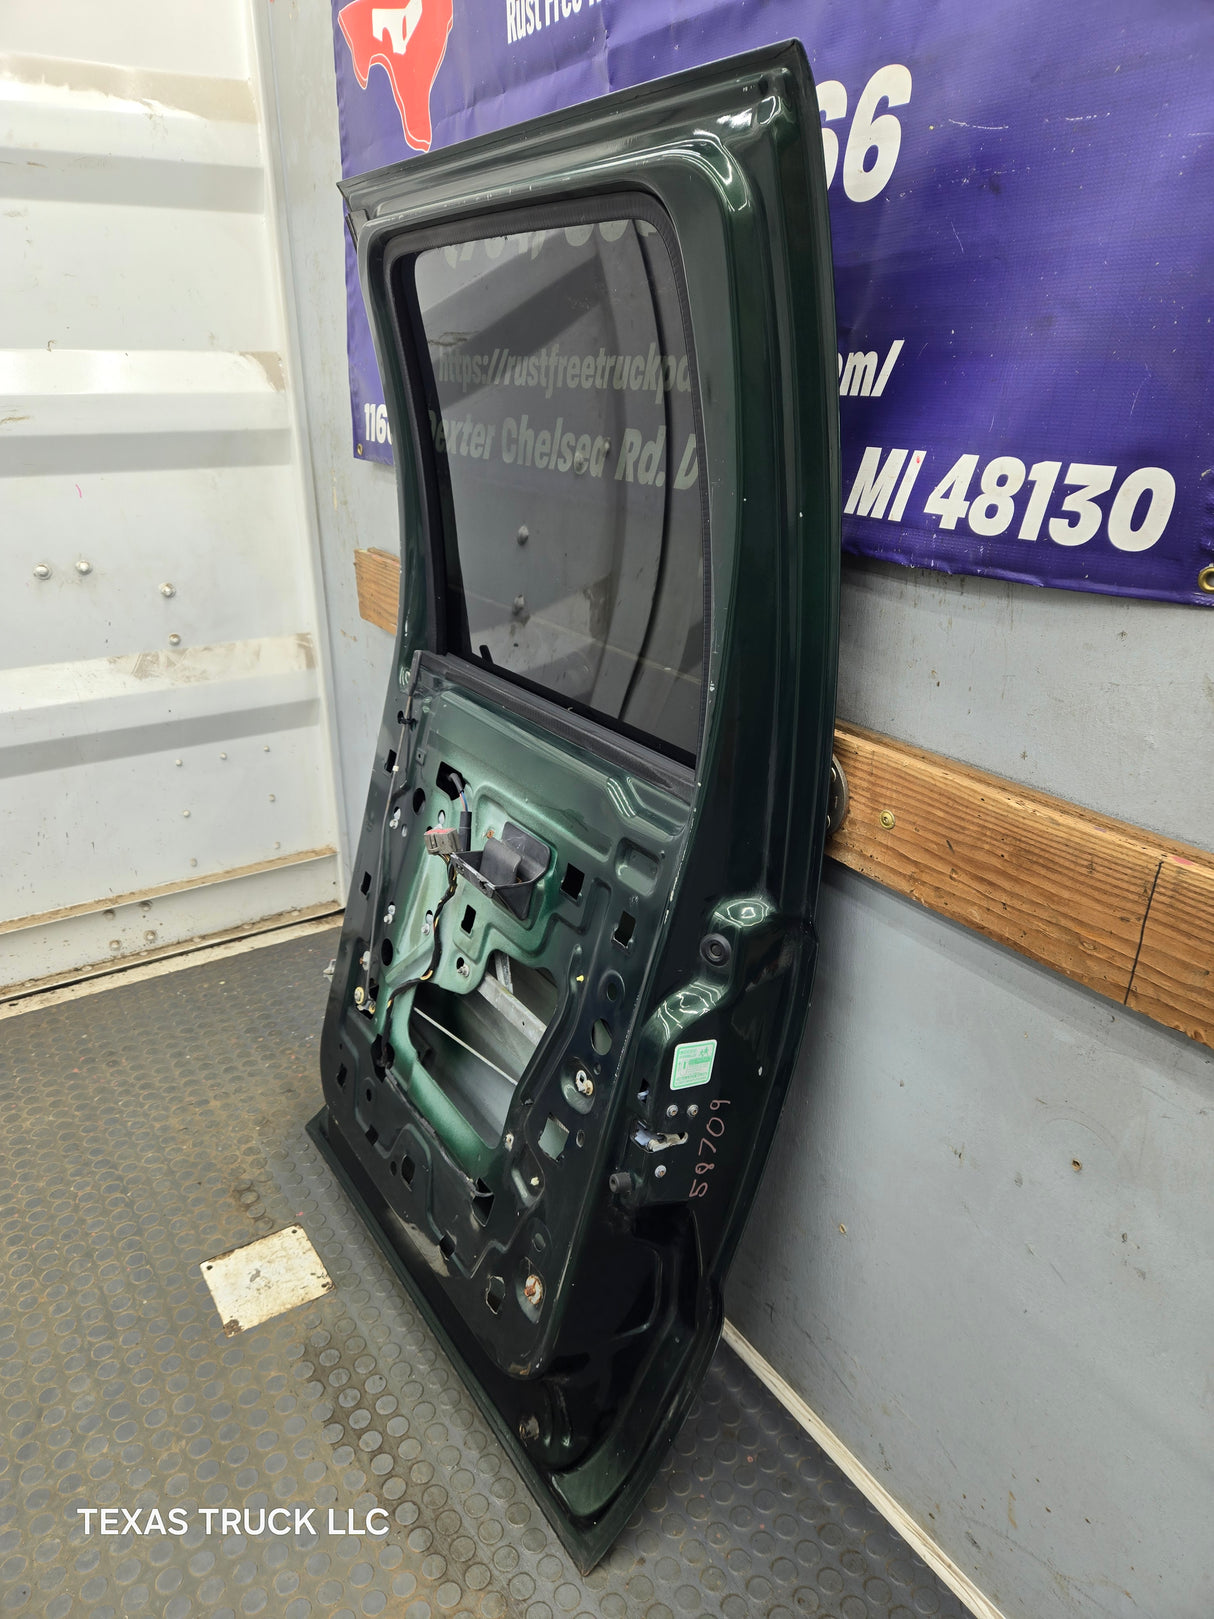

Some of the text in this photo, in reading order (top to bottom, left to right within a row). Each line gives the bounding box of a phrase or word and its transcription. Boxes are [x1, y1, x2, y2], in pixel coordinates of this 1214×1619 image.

[506, 0, 542, 44] Rust
[838, 340, 905, 397] m/
[502, 414, 612, 478] Chelsea
[614, 425, 667, 487] Rd.
[844, 447, 927, 522] MI
[923, 454, 1176, 552] 48130
[688, 1099, 731, 1198] 58709
